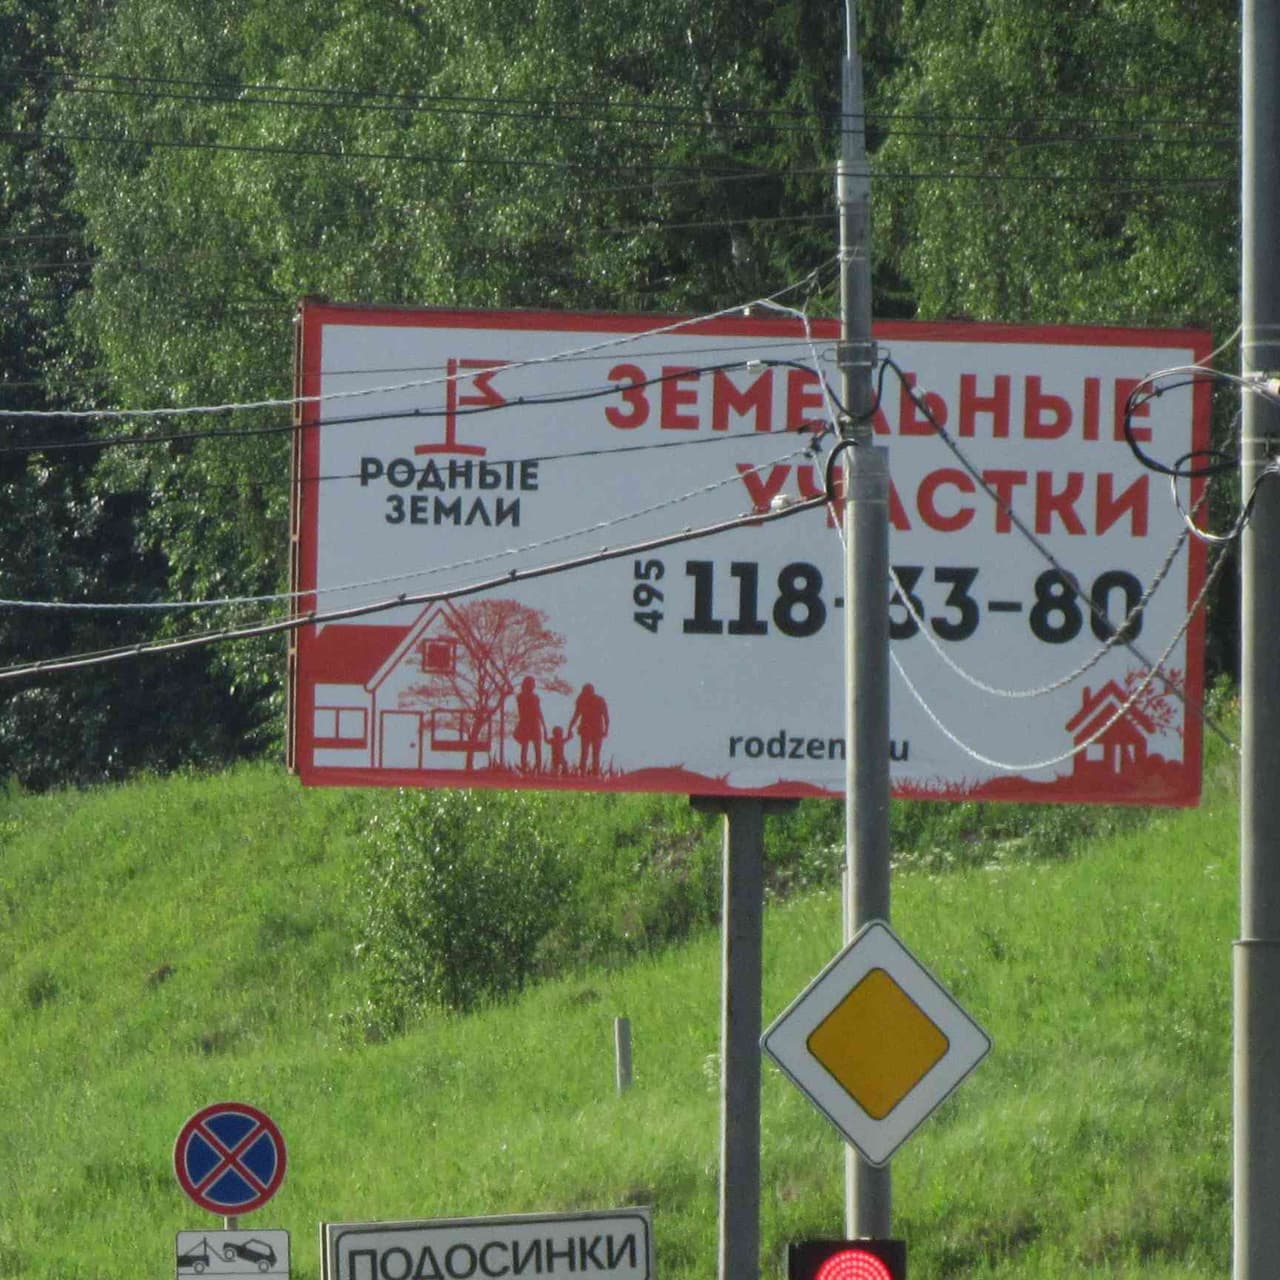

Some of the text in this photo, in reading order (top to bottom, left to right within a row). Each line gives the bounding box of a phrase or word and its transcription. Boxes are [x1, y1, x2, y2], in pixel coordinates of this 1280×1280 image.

[604, 363, 1153, 442] ЗЕМЕЬНЫЕ
[360, 456, 539, 492] РОДНЫЕ
[385, 494, 521, 528] ЗЕМЛИ
[736, 462, 1149, 537] УЧСТКИ
[633, 558, 665, 634] 495
